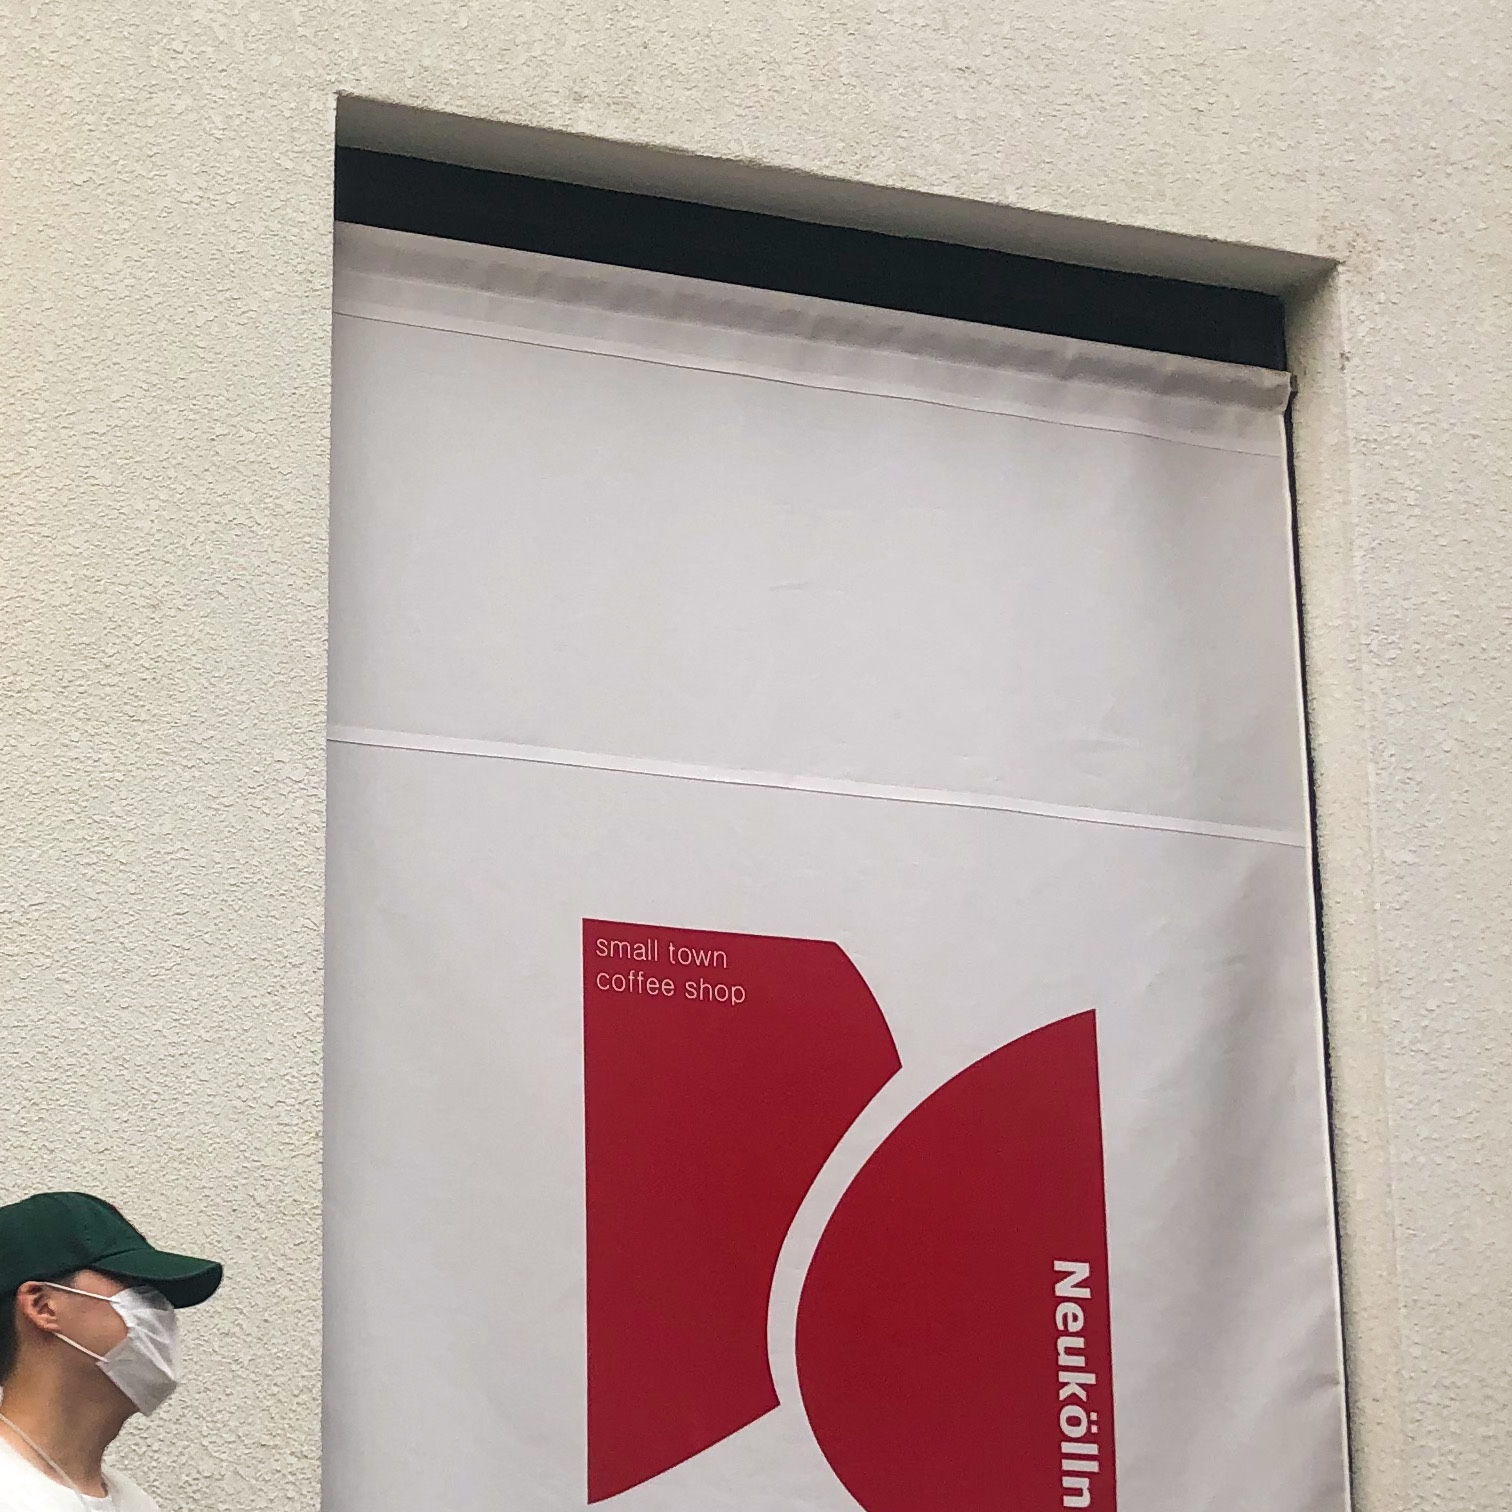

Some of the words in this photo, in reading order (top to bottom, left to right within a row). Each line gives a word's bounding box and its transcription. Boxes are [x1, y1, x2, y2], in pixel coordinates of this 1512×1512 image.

[595, 938, 658, 962] small
[668, 942, 728, 968] town
[596, 970, 675, 996] coffee
[684, 978, 746, 1005] shop
[1053, 1260, 1100, 1509] Neukölln
